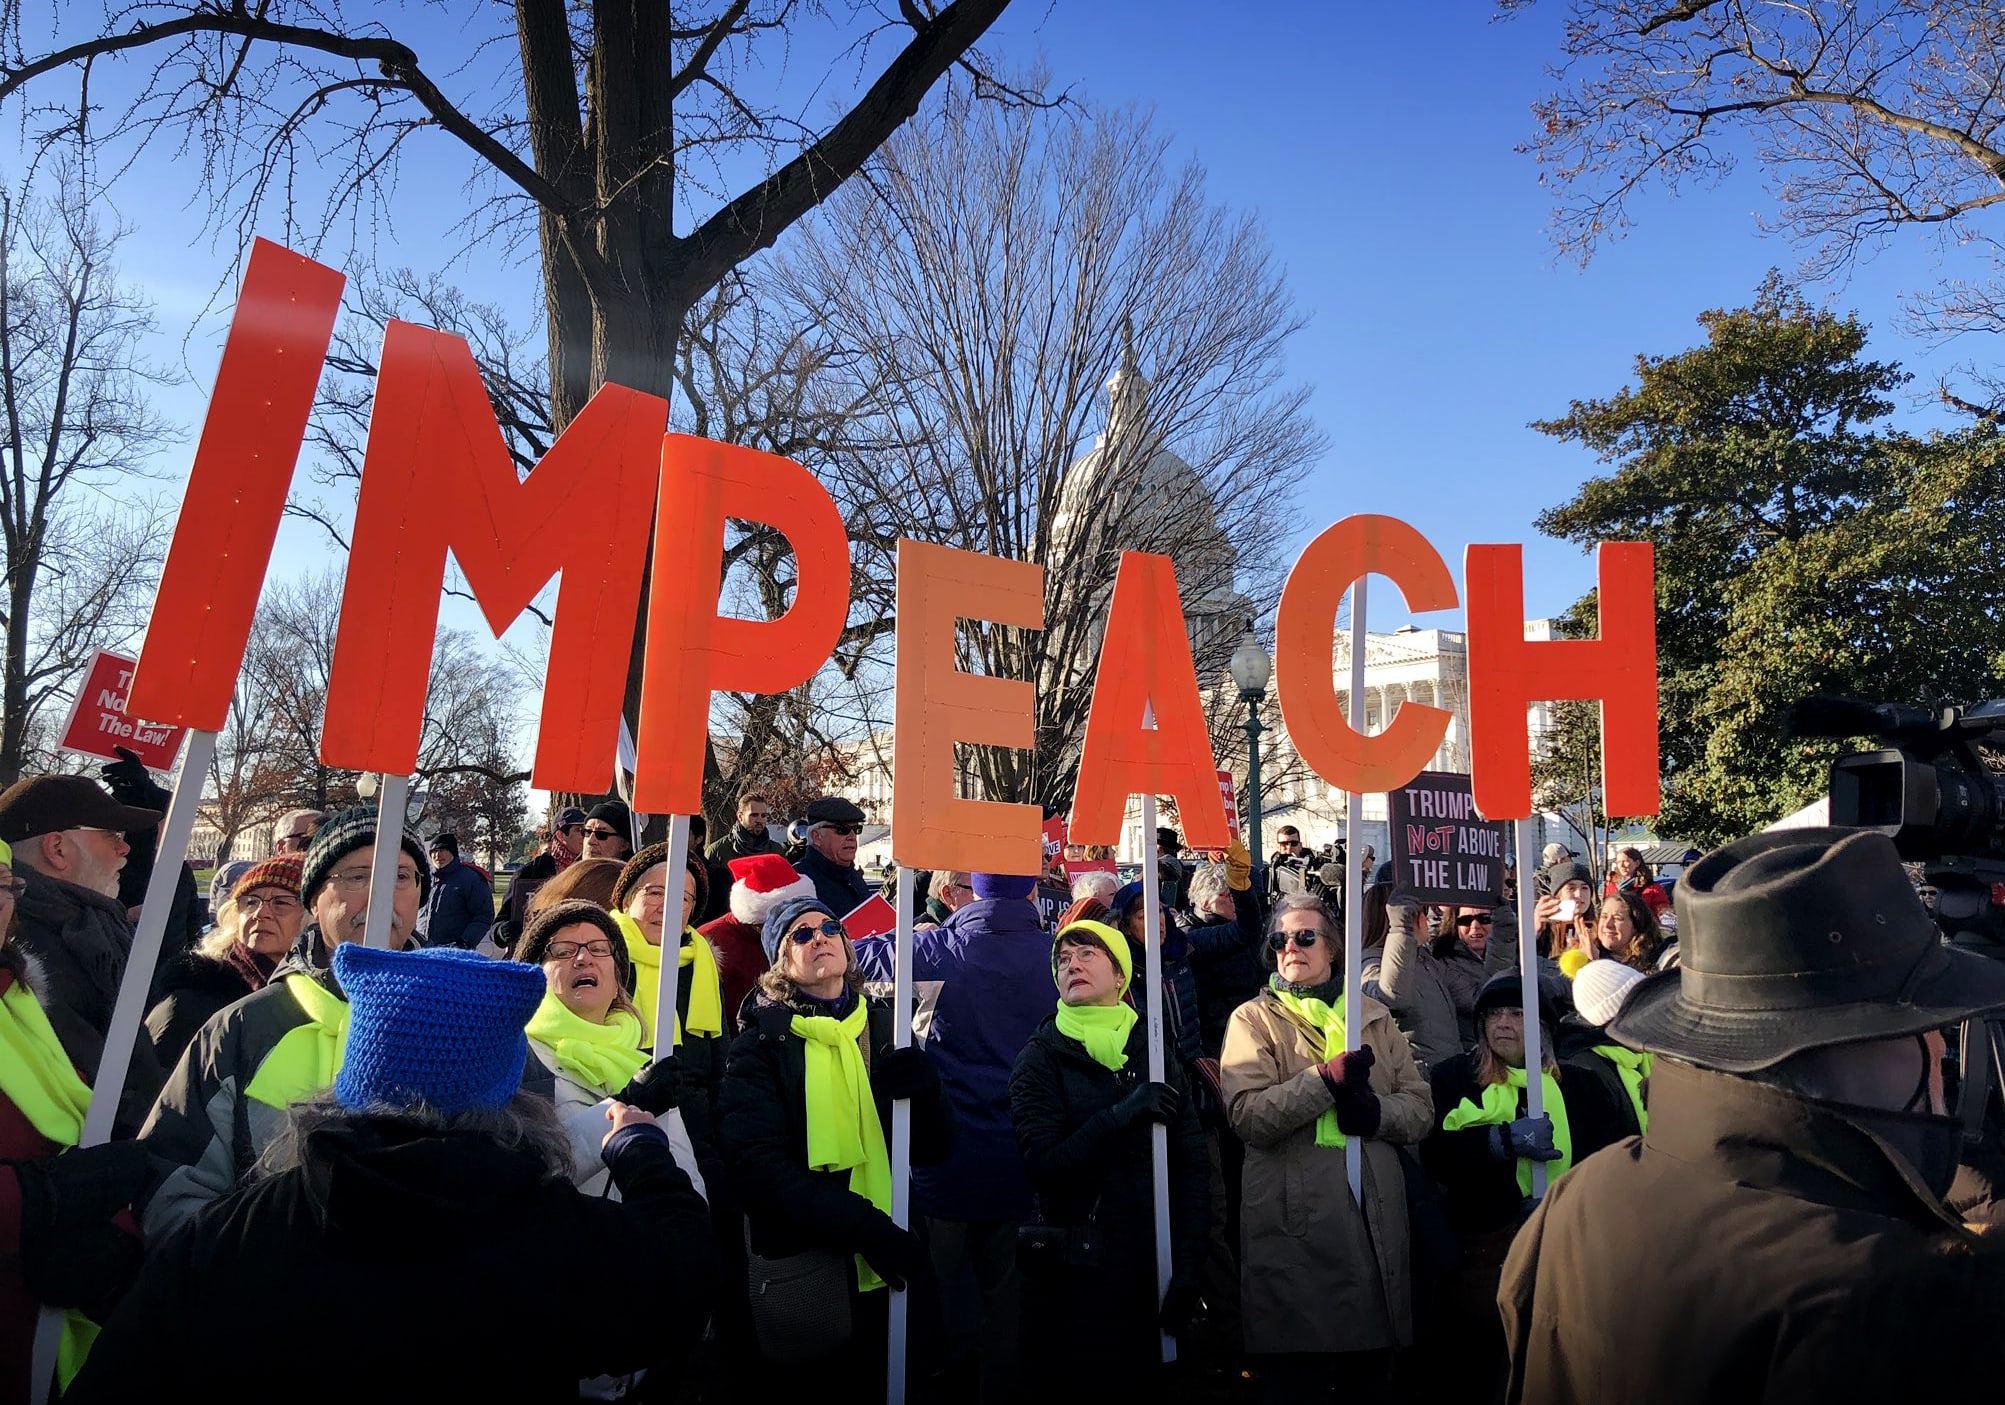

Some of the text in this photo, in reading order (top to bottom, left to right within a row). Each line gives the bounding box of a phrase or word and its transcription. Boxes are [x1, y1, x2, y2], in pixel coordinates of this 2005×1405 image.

[127, 237, 1659, 876] IMPEACH
[99, 712, 172, 747] The Law!
[1405, 789, 1473, 820] TRUMP
[1458, 826, 1501, 858] ABOVE
[1409, 859, 1491, 892] THE LAW.
